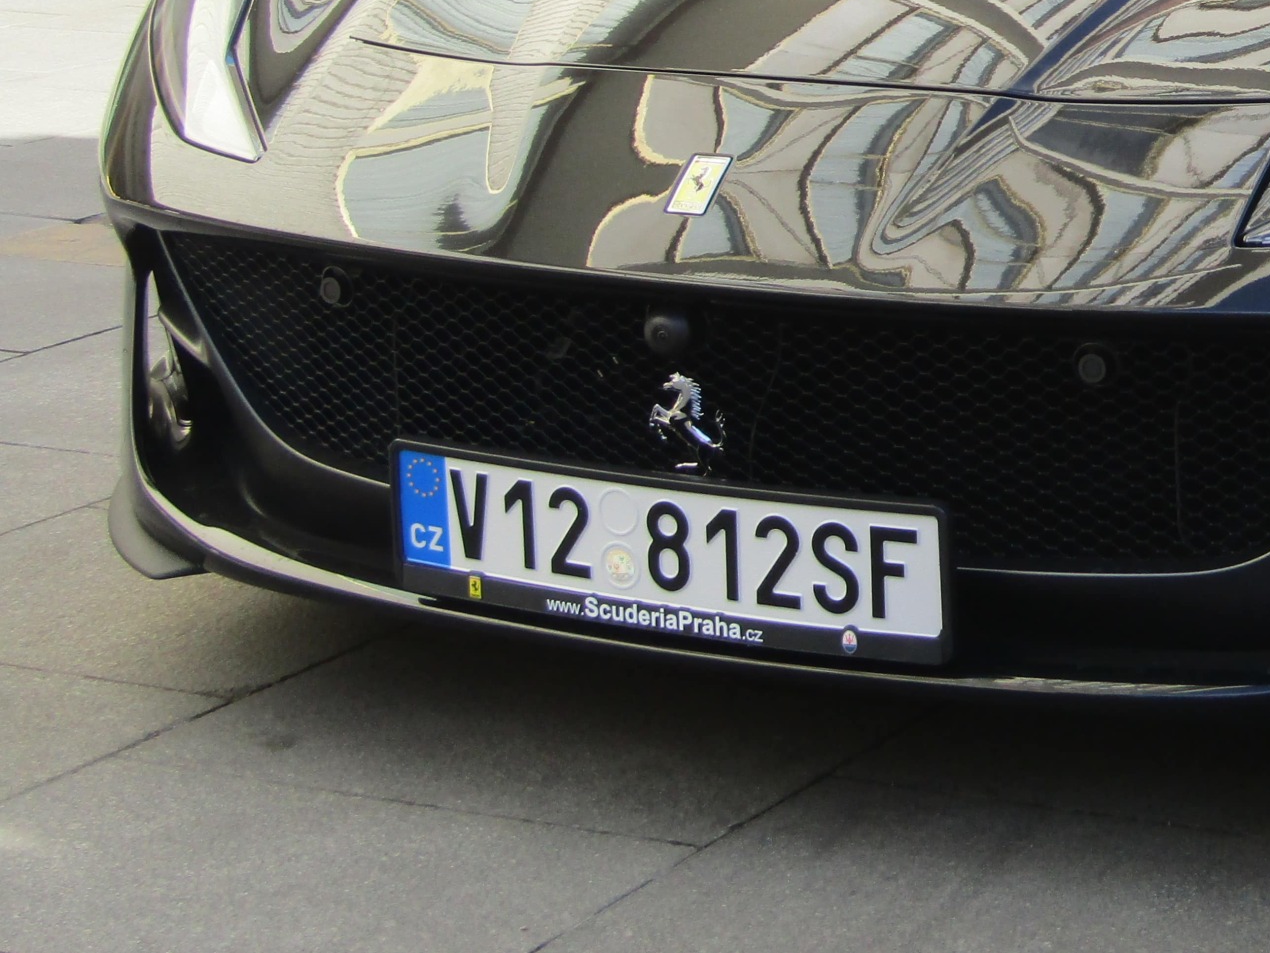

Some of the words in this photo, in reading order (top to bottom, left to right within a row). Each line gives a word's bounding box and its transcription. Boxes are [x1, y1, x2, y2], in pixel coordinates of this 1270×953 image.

[410, 522, 444, 552] CZ
[449, 468, 592, 580] V12
[646, 500, 918, 619] 812SF
[546, 596, 764, 643] www.ScuderiaPraha.cz
